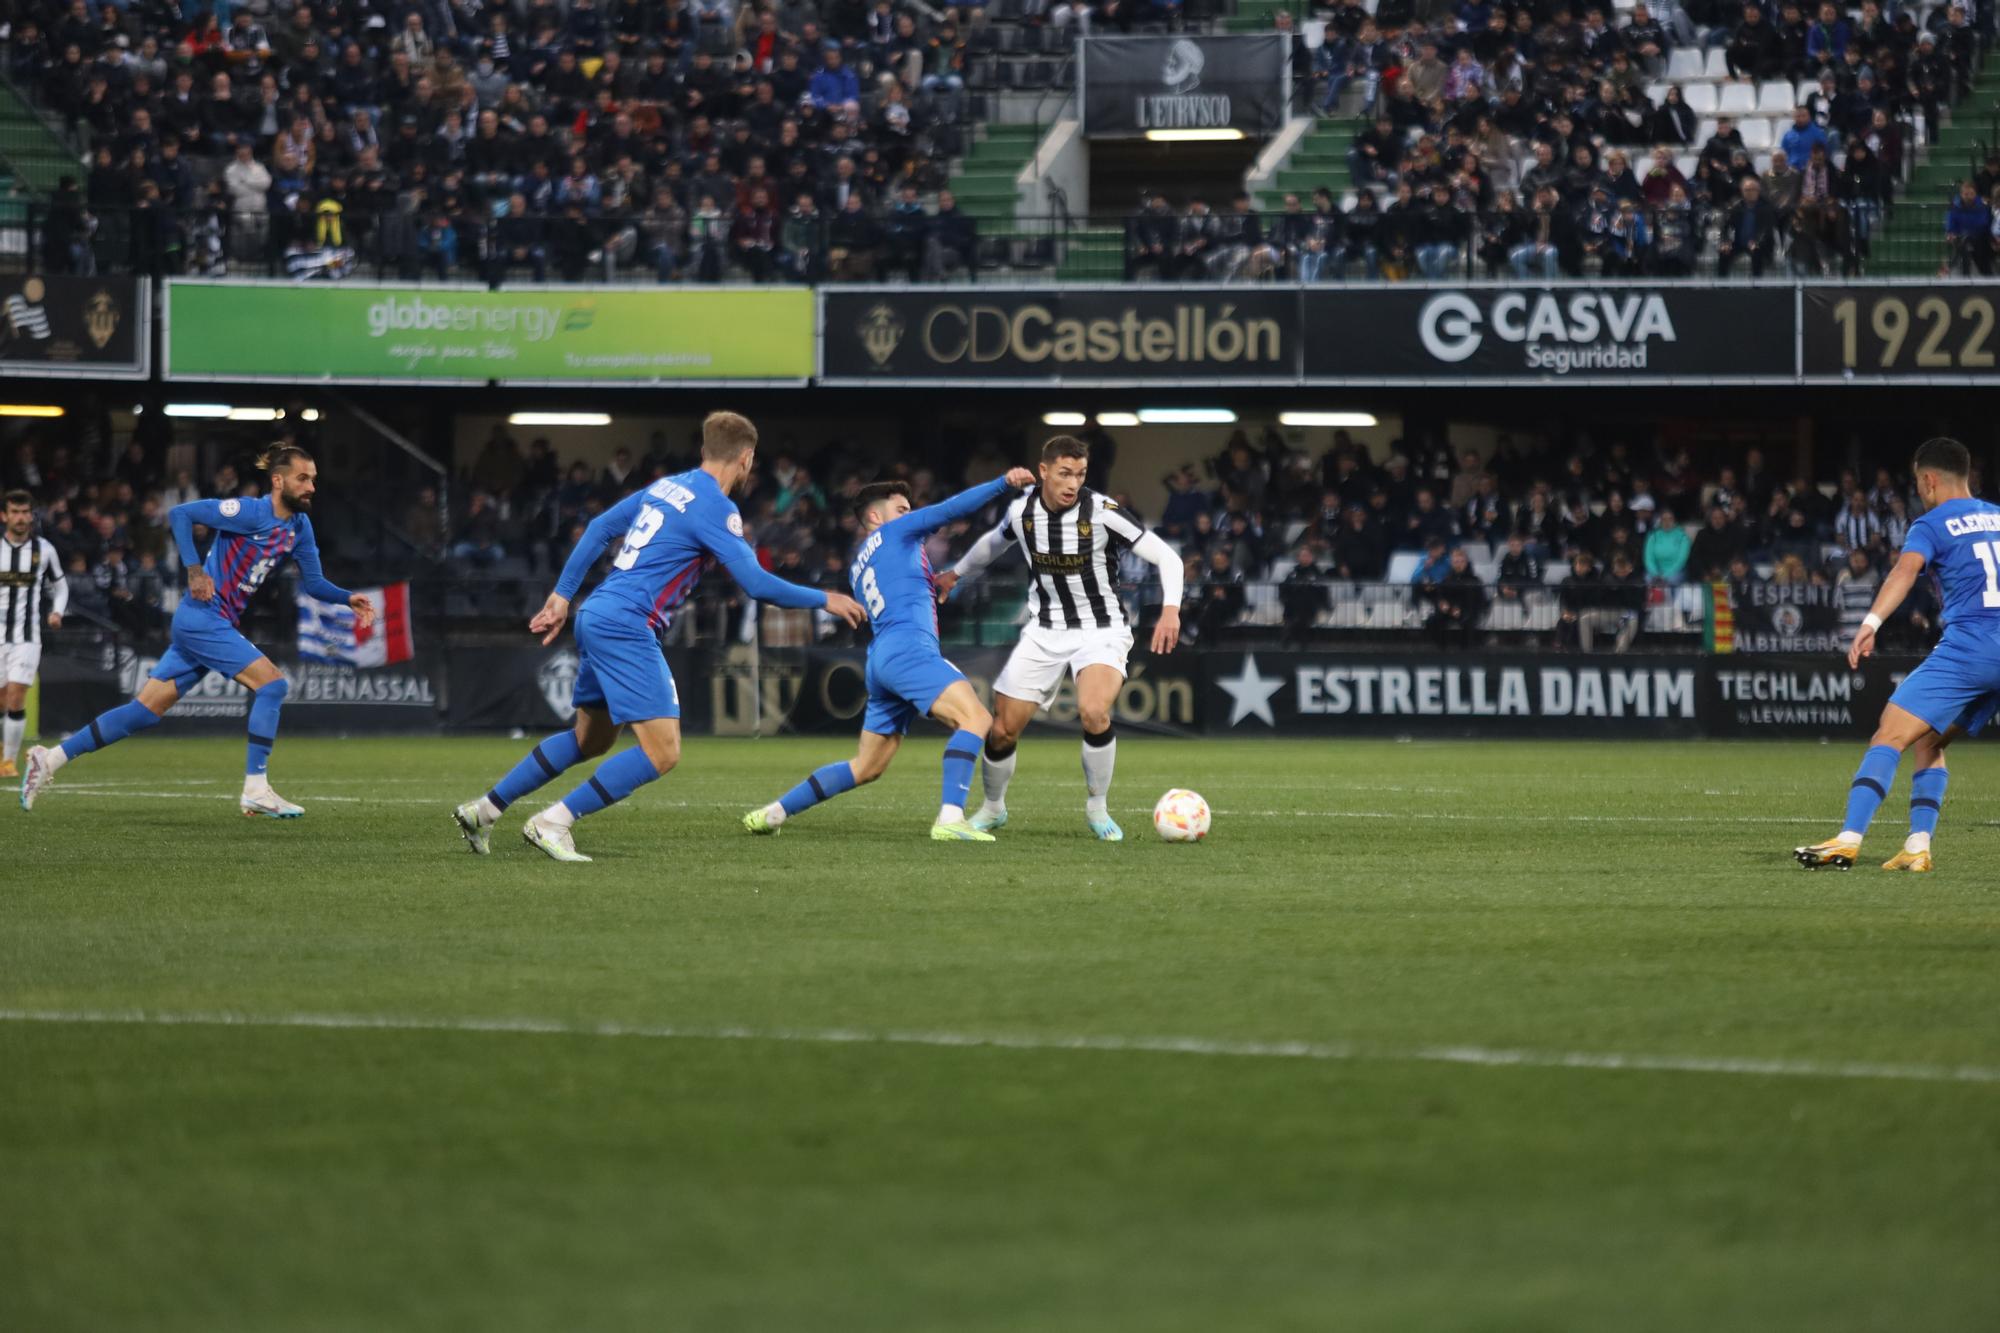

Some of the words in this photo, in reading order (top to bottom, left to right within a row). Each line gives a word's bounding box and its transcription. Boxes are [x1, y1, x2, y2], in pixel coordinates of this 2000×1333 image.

[367, 297, 561, 341] globeenergy
[1491, 292, 1677, 343] CASVA
[1833, 297, 1995, 367] 1922
[1526, 345, 1648, 373] Seguridad
[1945, 512, 2000, 537] CLEME
[862, 566, 886, 619] 8
[1972, 541, 2000, 608] 1
[1297, 666, 1530, 716] ESTRELLA
[1540, 668, 1696, 718] DAMM
